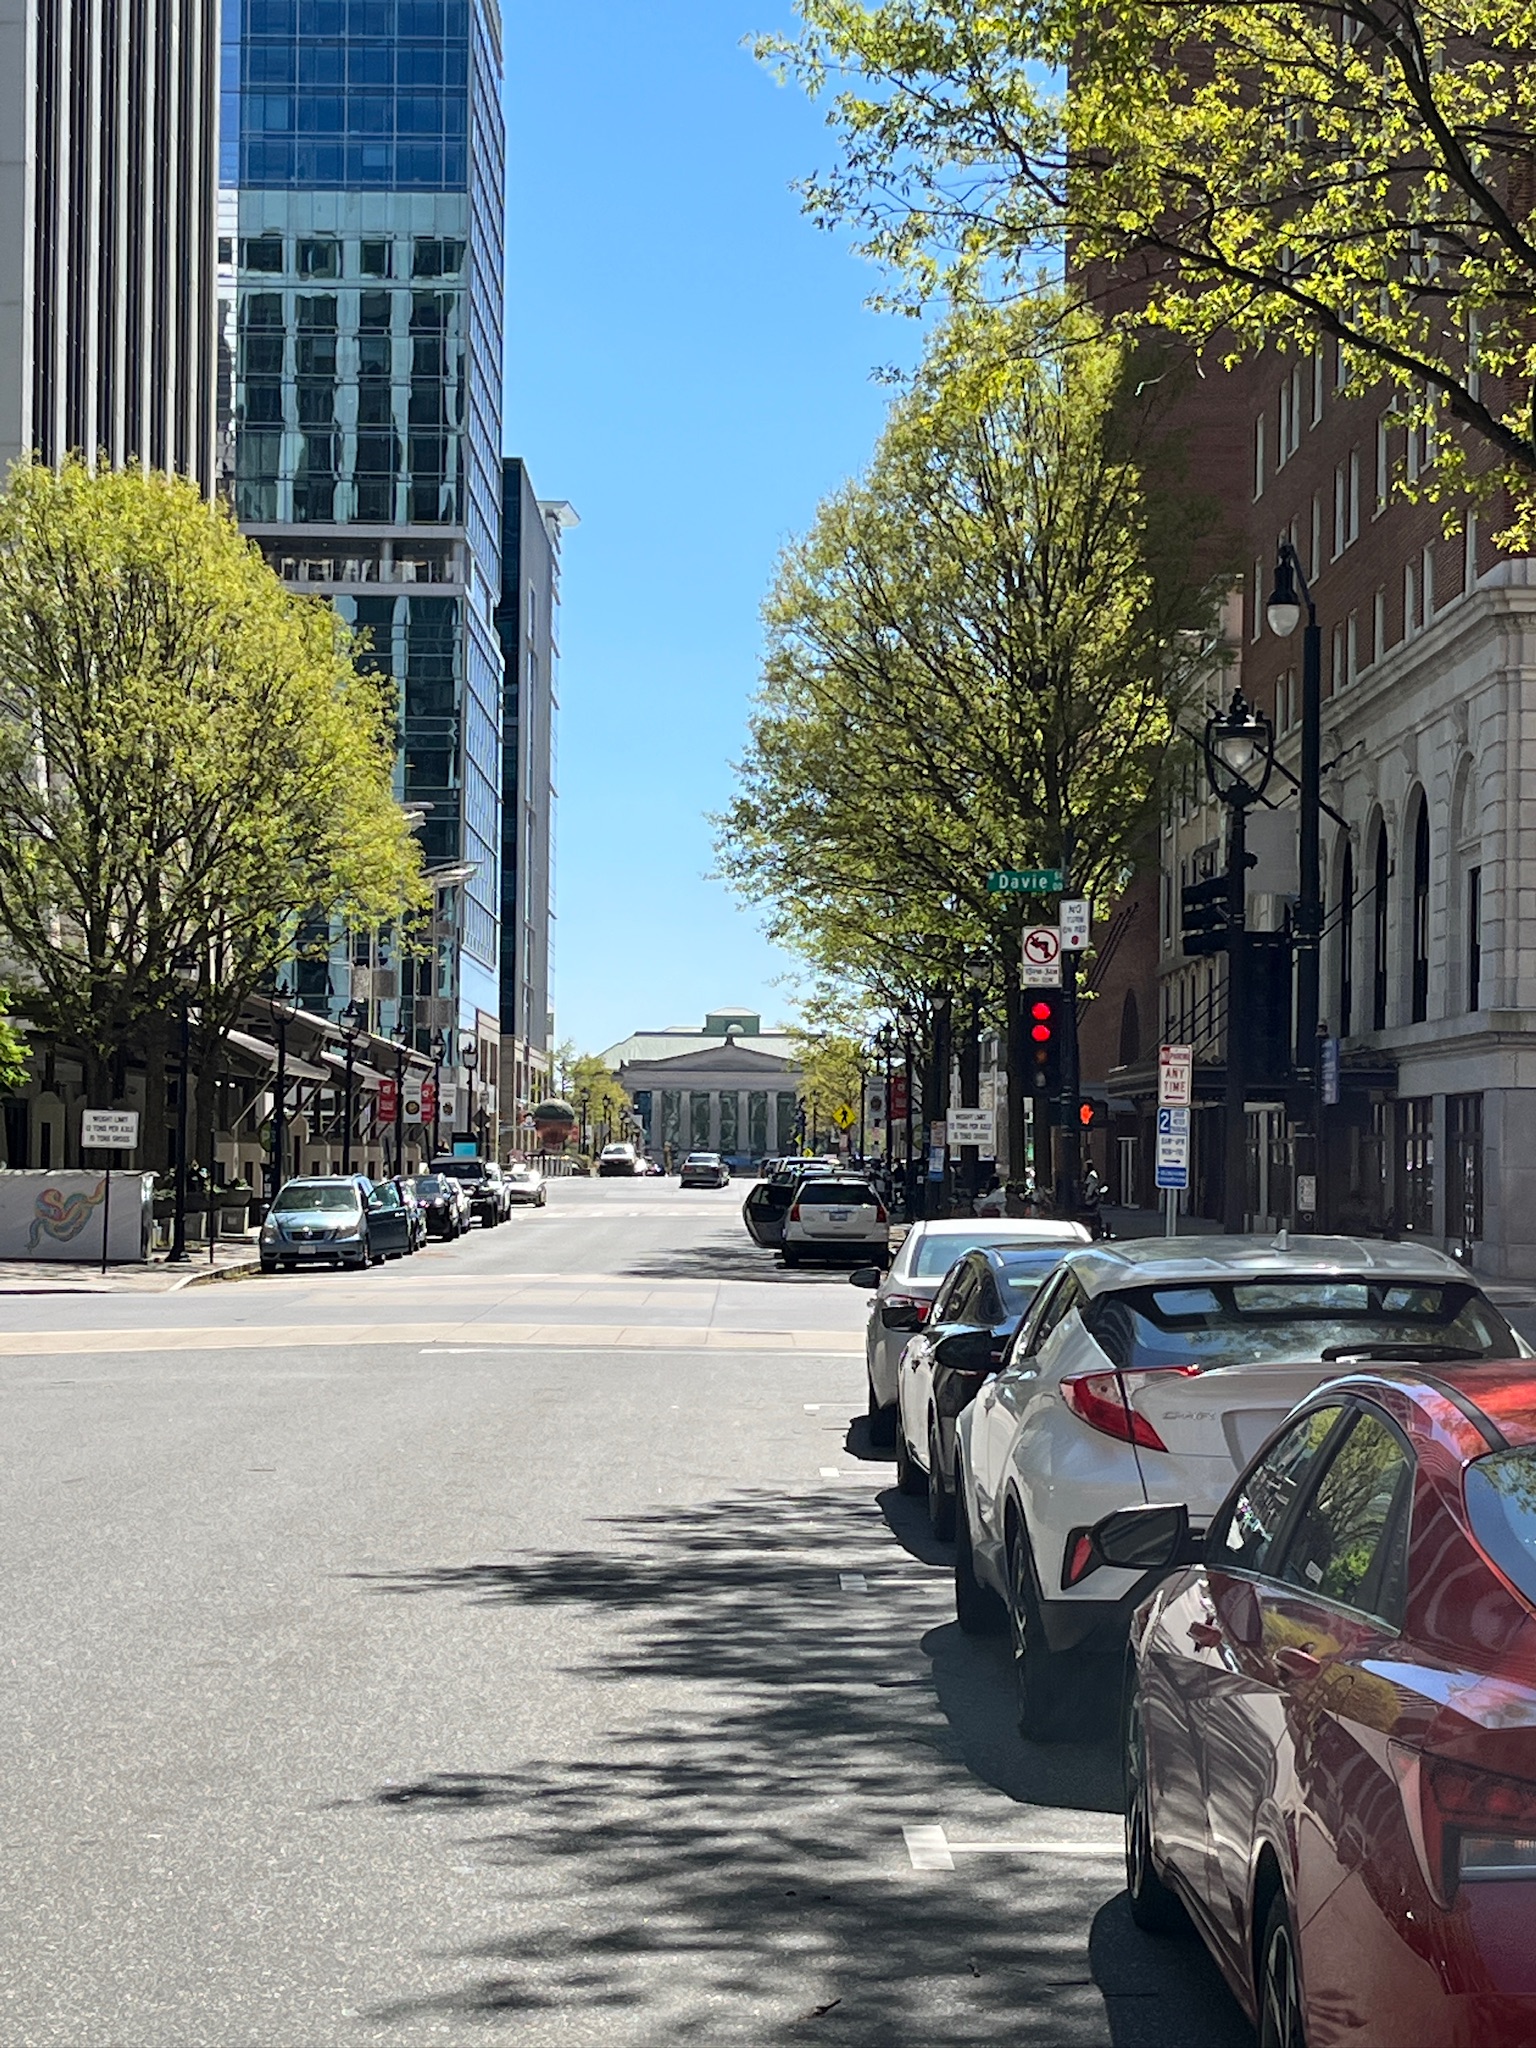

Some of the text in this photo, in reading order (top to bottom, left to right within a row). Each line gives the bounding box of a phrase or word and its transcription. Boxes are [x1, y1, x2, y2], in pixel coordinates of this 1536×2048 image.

[999, 873, 1048, 889] Davie
[1068, 904, 1082, 914] NO
[1062, 925, 1087, 934] ON RED
[1165, 1068, 1185, 1079] ANY
[1164, 1081, 1186, 1093] TIME
[1160, 1111, 1169, 1131] 2
